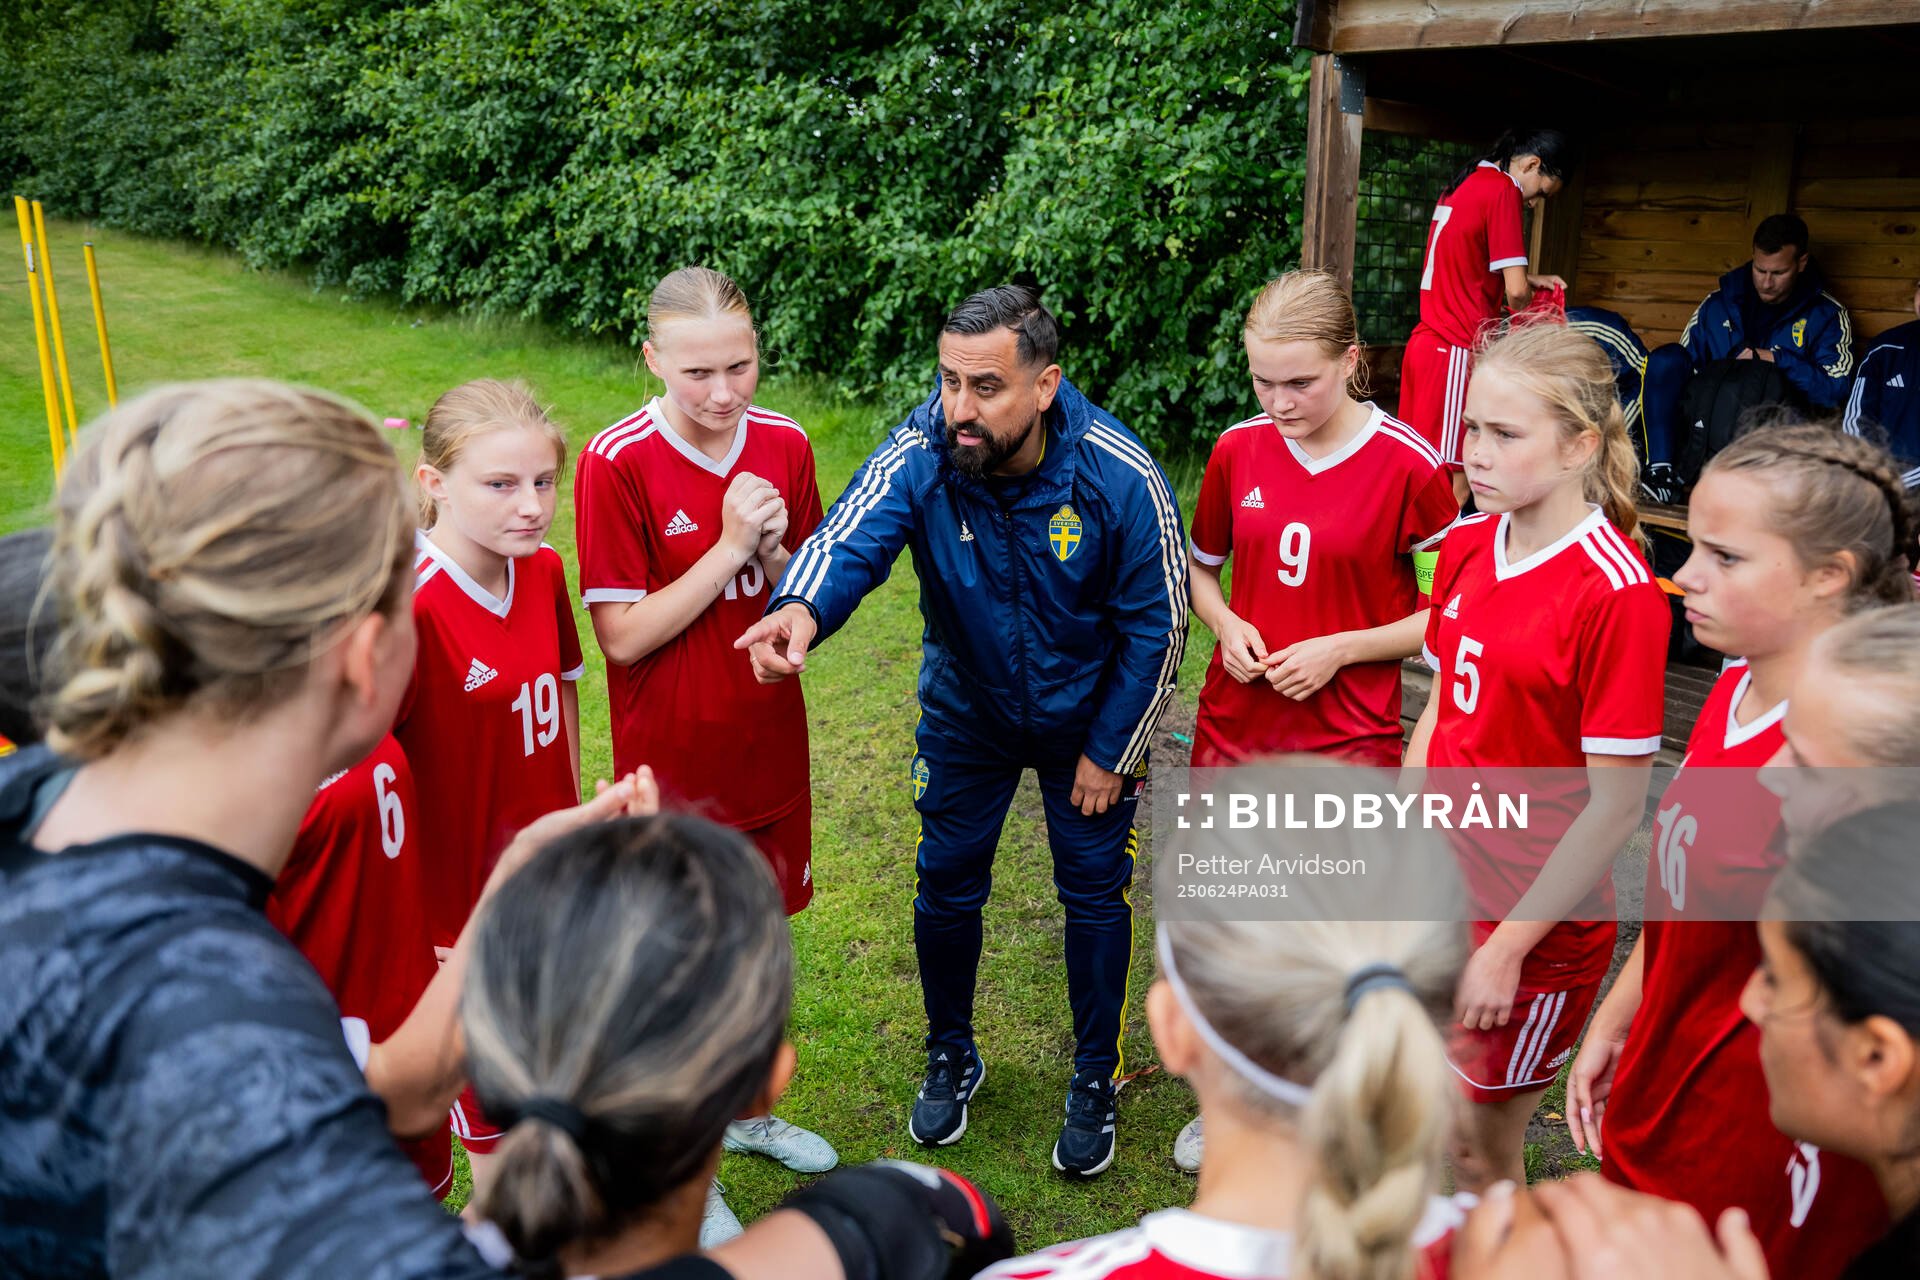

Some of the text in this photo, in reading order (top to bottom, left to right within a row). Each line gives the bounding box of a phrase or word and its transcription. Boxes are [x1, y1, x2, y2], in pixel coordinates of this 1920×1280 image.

[665, 523, 699, 536] adidas
[1241, 499, 1264, 509] adidas
[1278, 522, 1311, 587] 9
[464, 668, 498, 692] adidas
[1453, 635, 1484, 714] 5
[511, 672, 560, 757] 19
[373, 762, 405, 859] 6
[1657, 802, 1698, 912] 16
